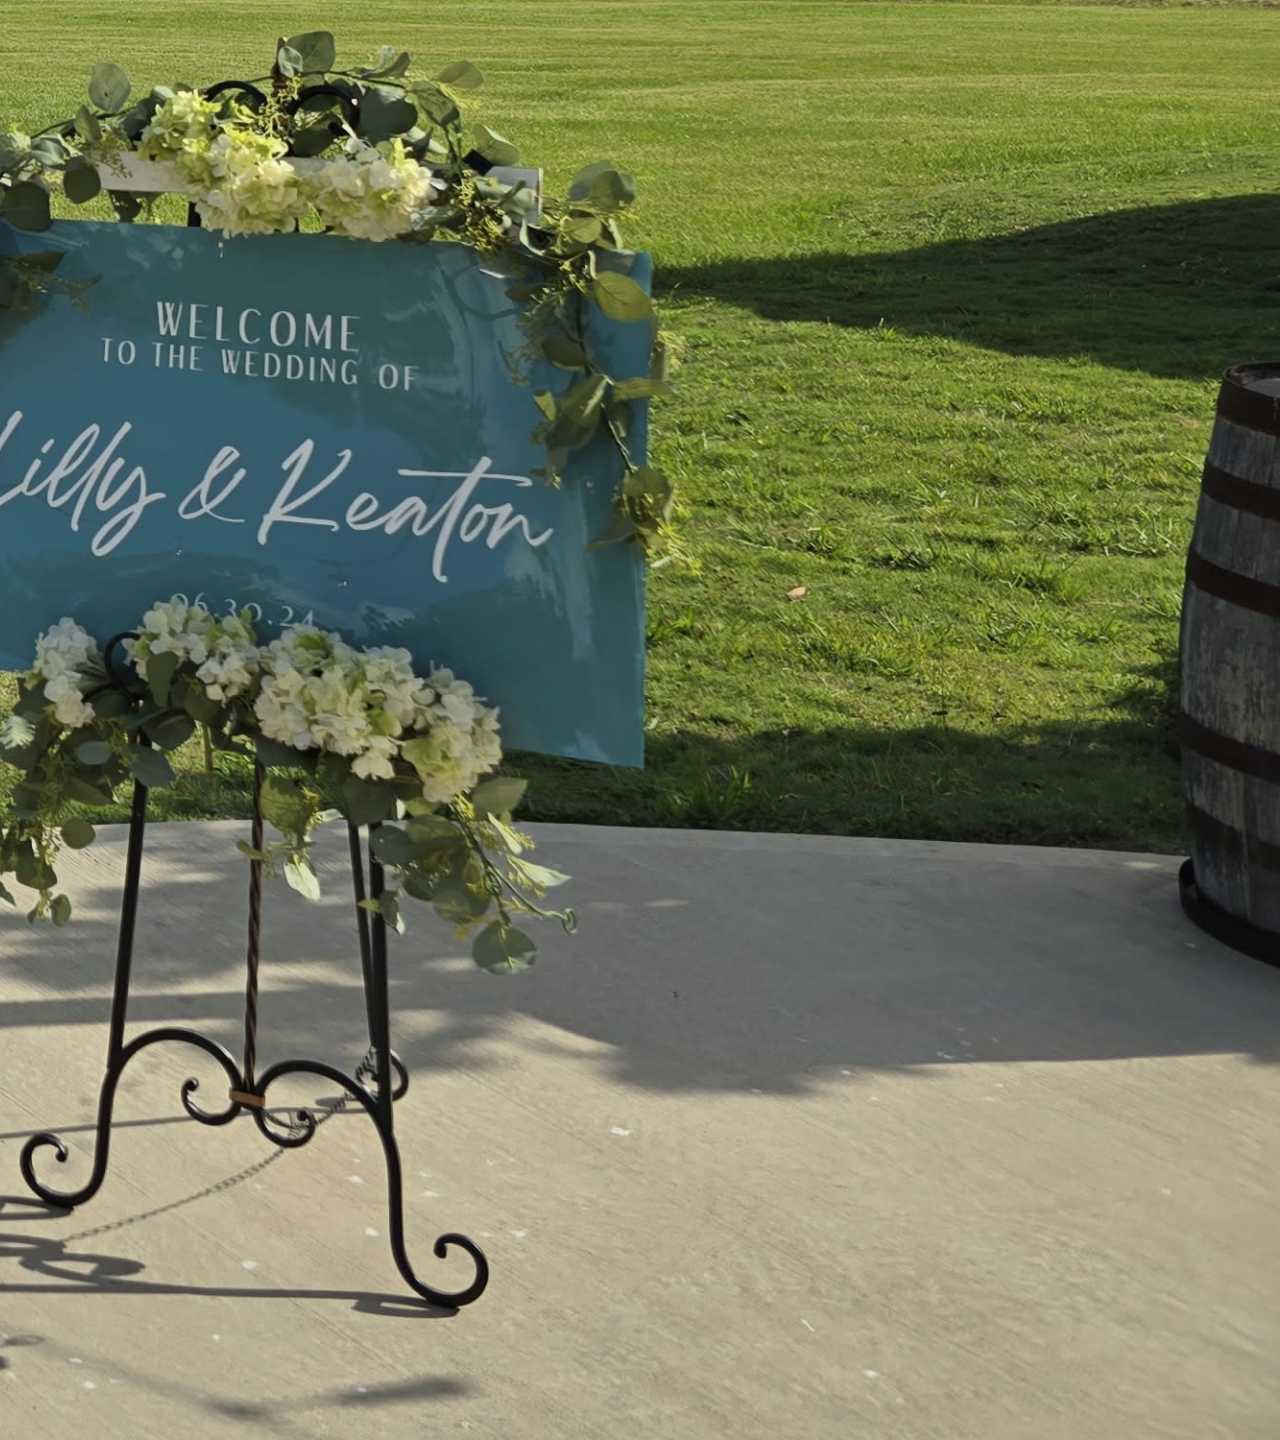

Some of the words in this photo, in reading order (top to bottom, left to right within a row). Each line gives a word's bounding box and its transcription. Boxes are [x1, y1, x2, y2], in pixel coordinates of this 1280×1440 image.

[156, 301, 361, 352] WELCOME
[101, 337, 136, 365] TO
[151, 342, 204, 372] THE
[220, 348, 359, 385] WEDDING
[378, 363, 419, 392] OF
[178, 445, 247, 523] &
[257, 438, 554, 583] Keaton
